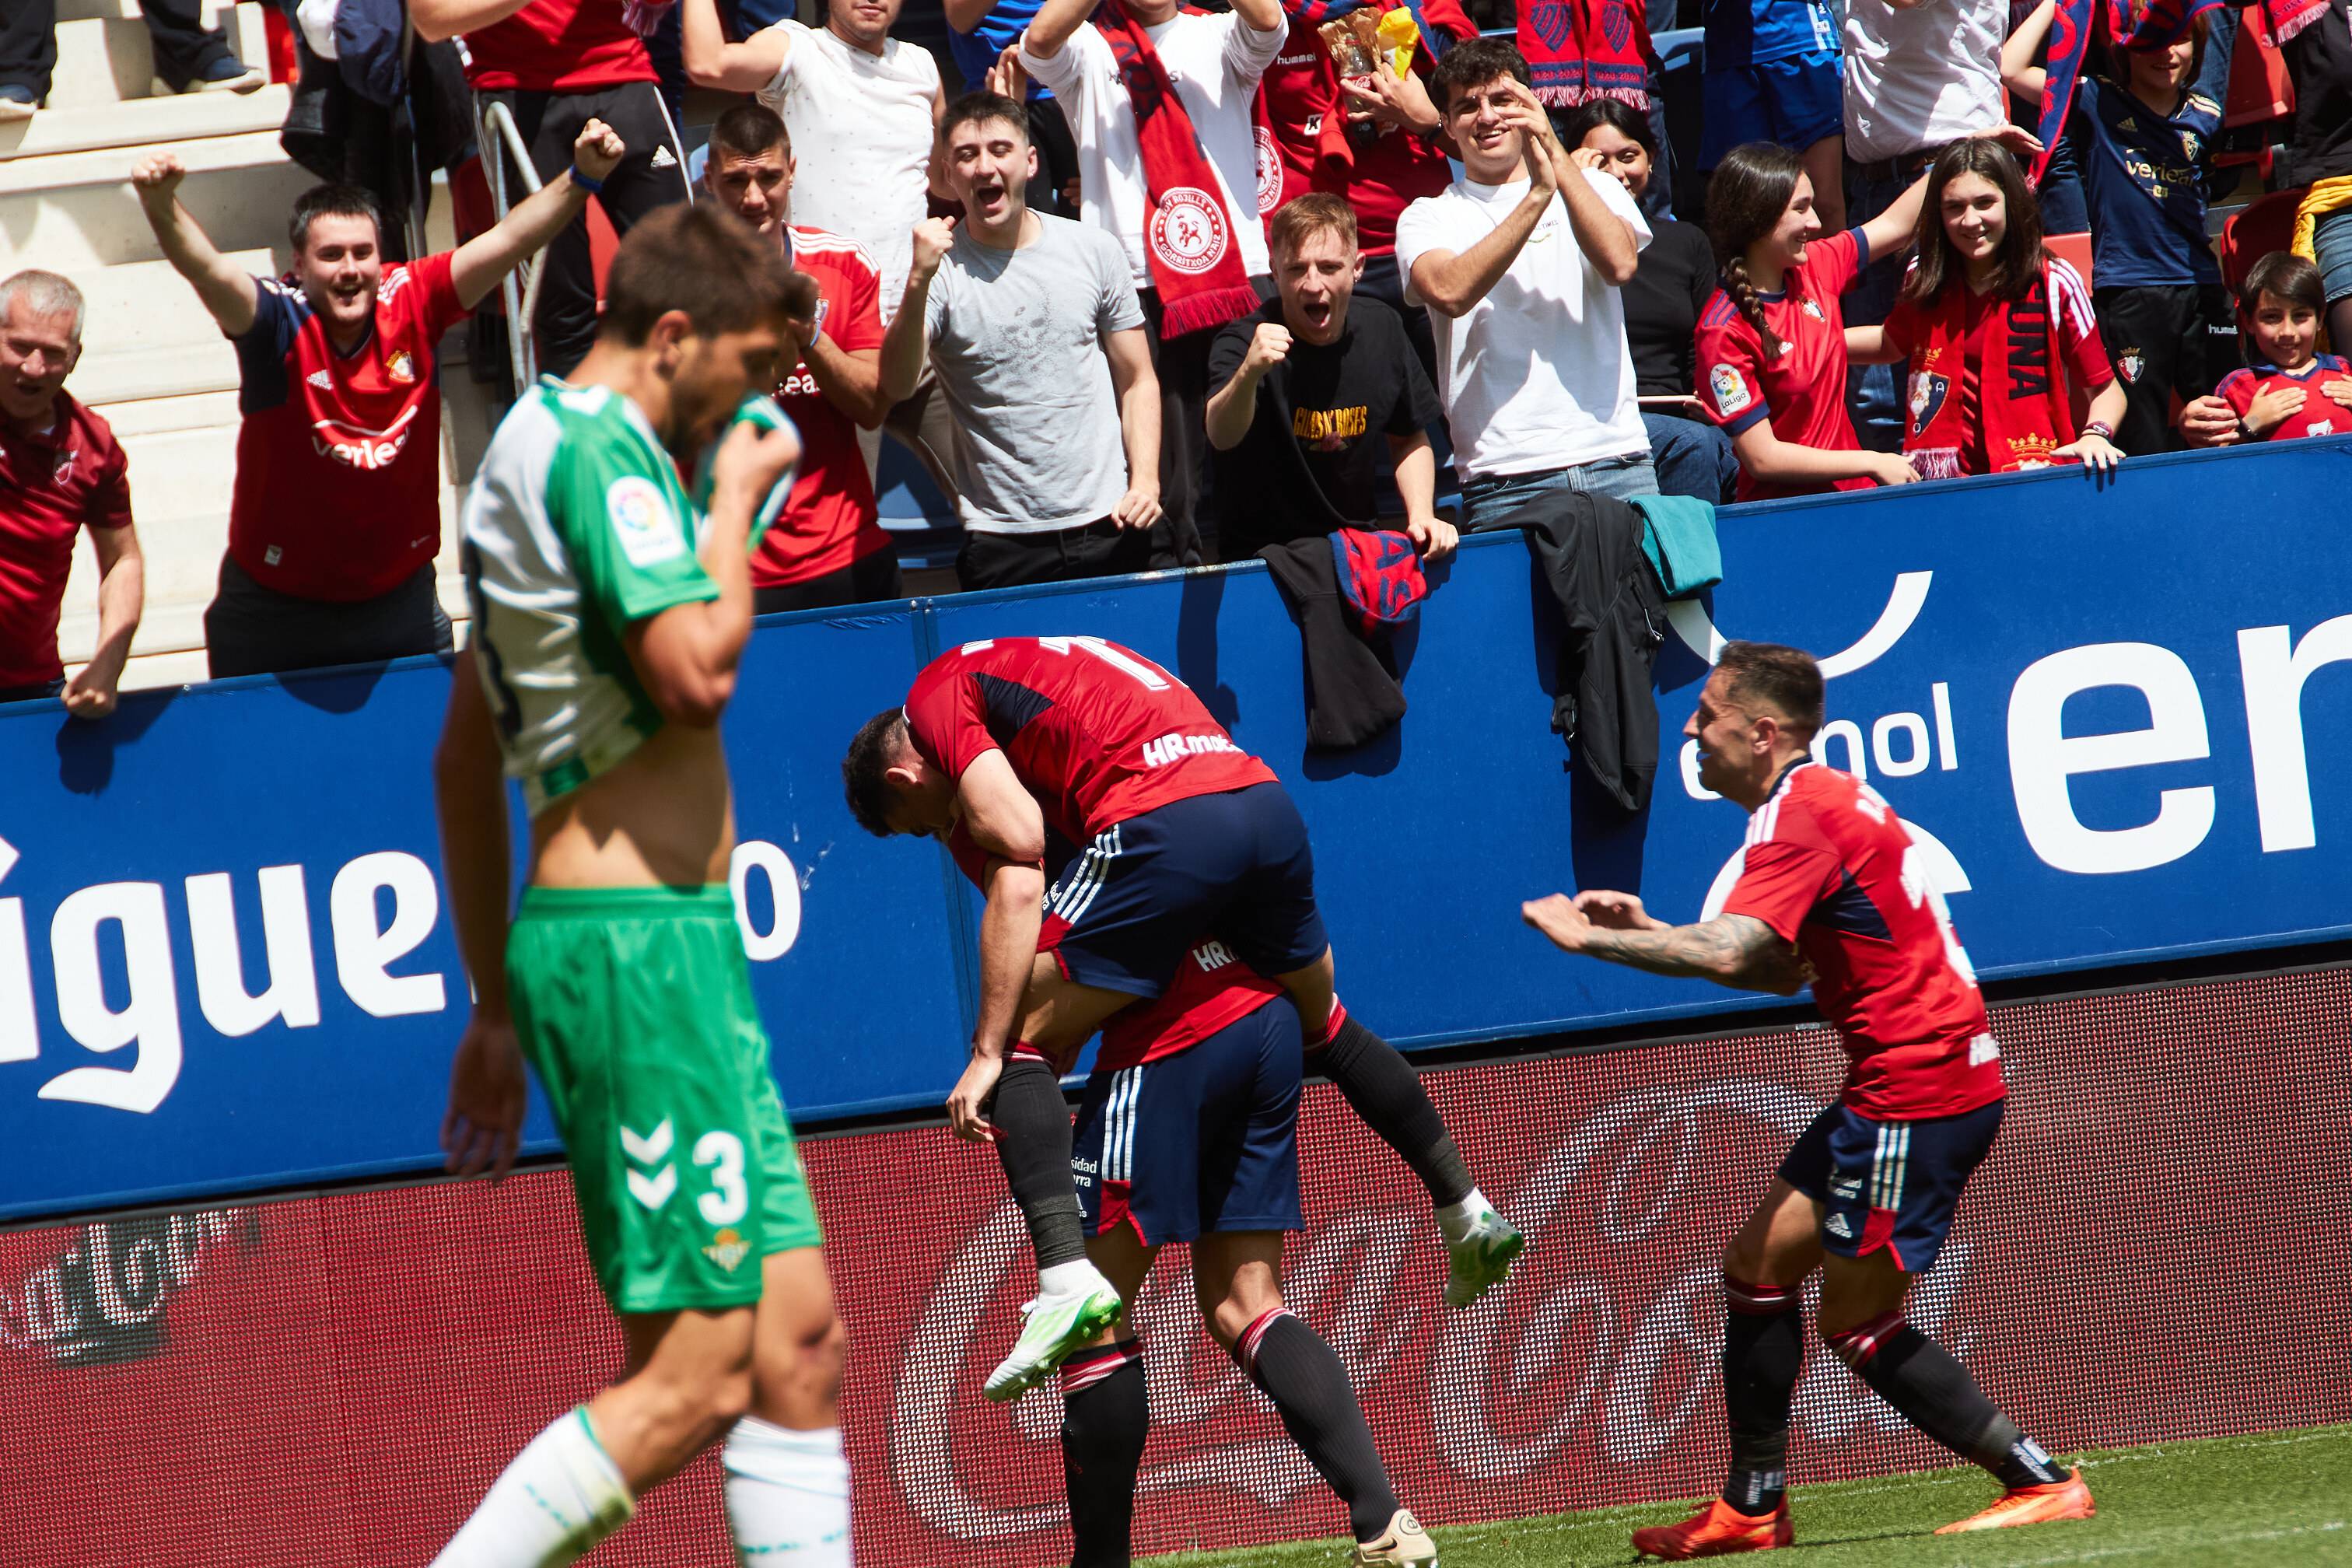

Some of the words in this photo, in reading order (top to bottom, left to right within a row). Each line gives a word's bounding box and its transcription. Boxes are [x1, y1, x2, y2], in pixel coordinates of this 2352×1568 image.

[1277, 52, 1317, 65] hummel
[2007, 280, 2048, 401] UNA
[1335, 405, 1367, 438] ROSES
[1721, 392, 1746, 409] LaLiga
[0, 836, 467, 1114] igue
[691, 1130, 749, 1225] 3
